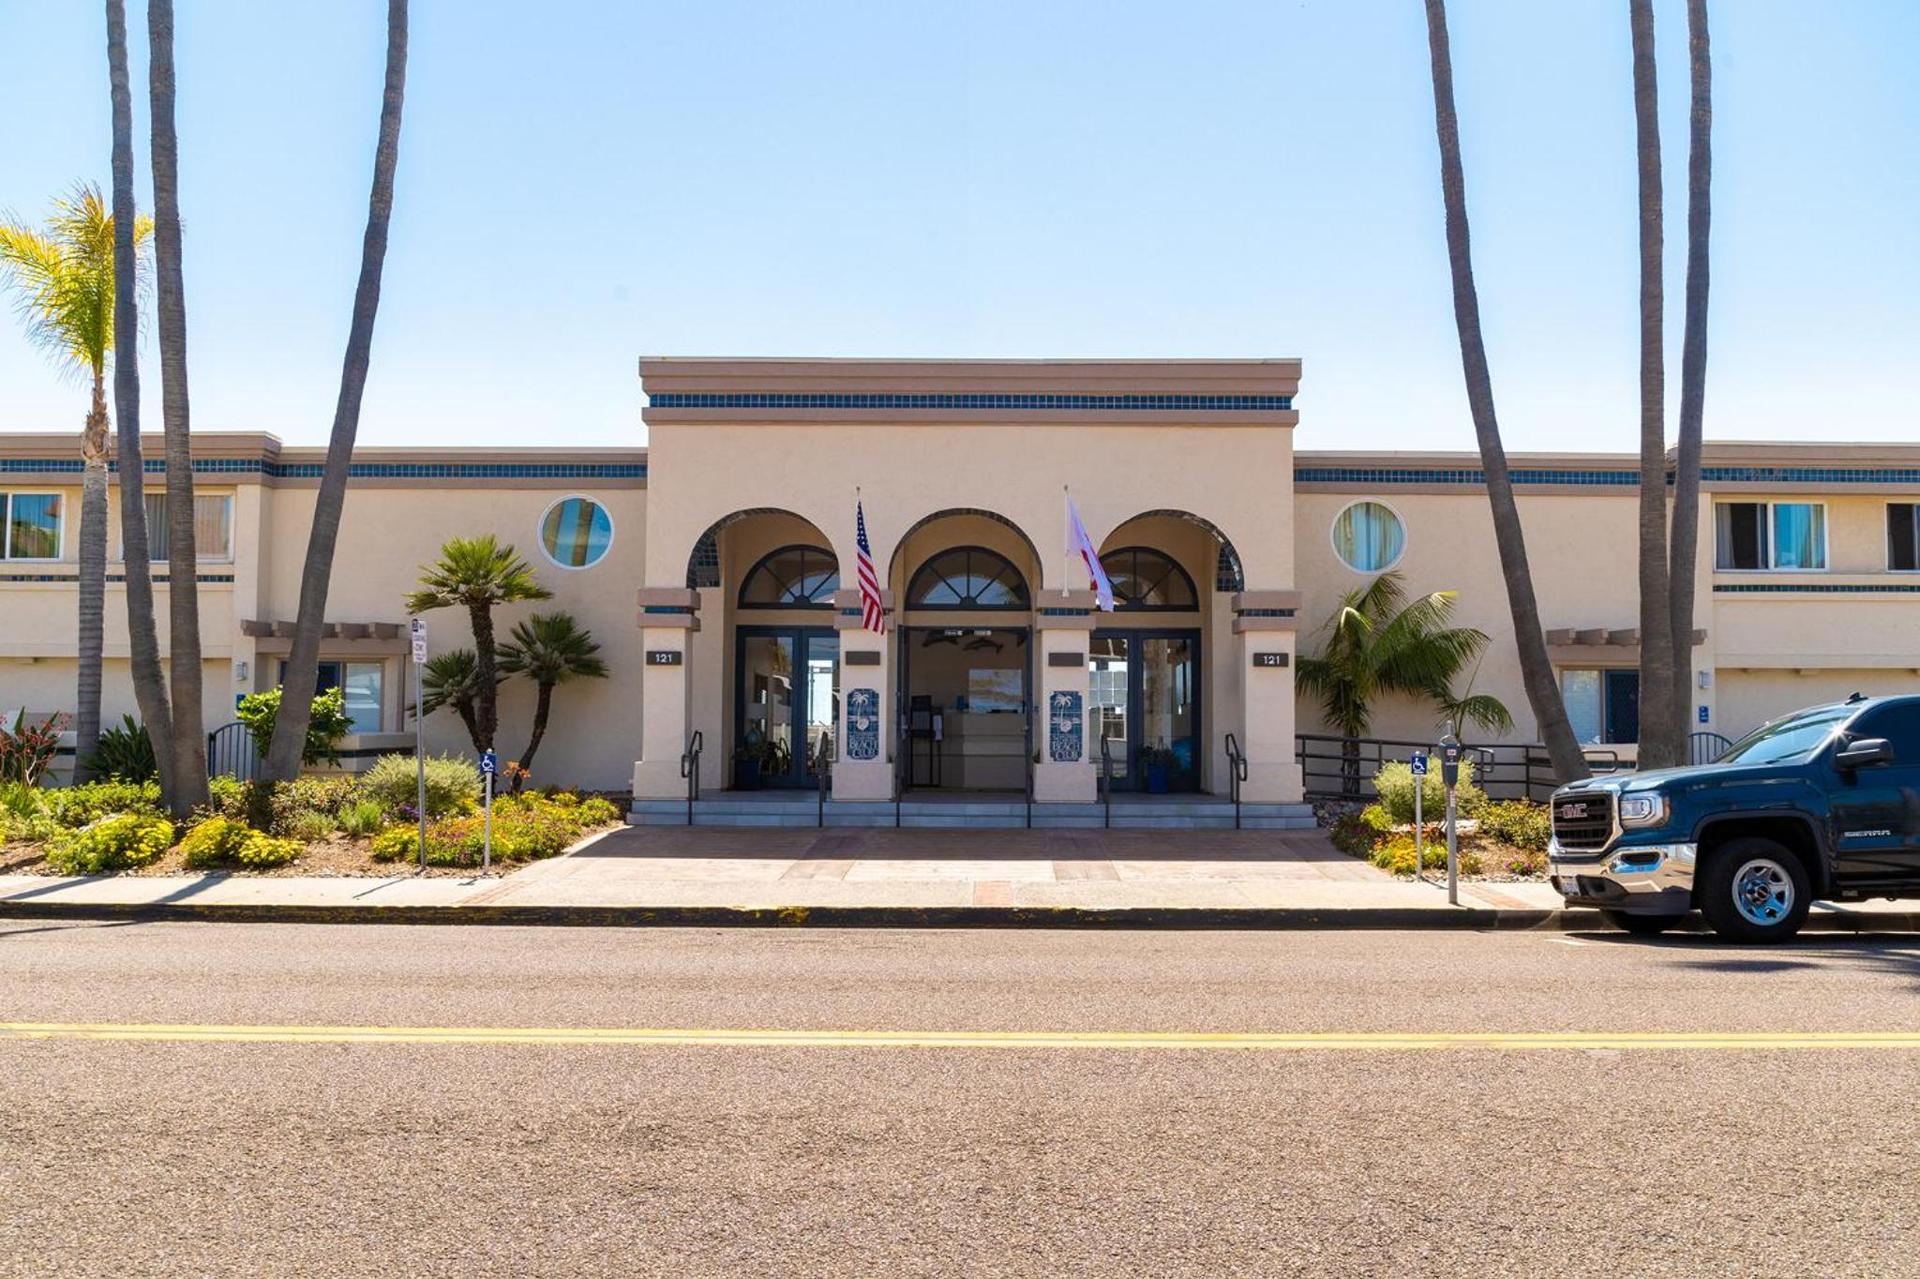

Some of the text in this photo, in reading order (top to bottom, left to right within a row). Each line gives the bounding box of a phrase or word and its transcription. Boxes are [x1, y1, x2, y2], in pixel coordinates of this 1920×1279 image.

[655, 653, 672, 663] 121
[1264, 655, 1280, 665] 121
[1561, 803, 1588, 819] GMC
[1844, 830, 1891, 838] SIERRA
